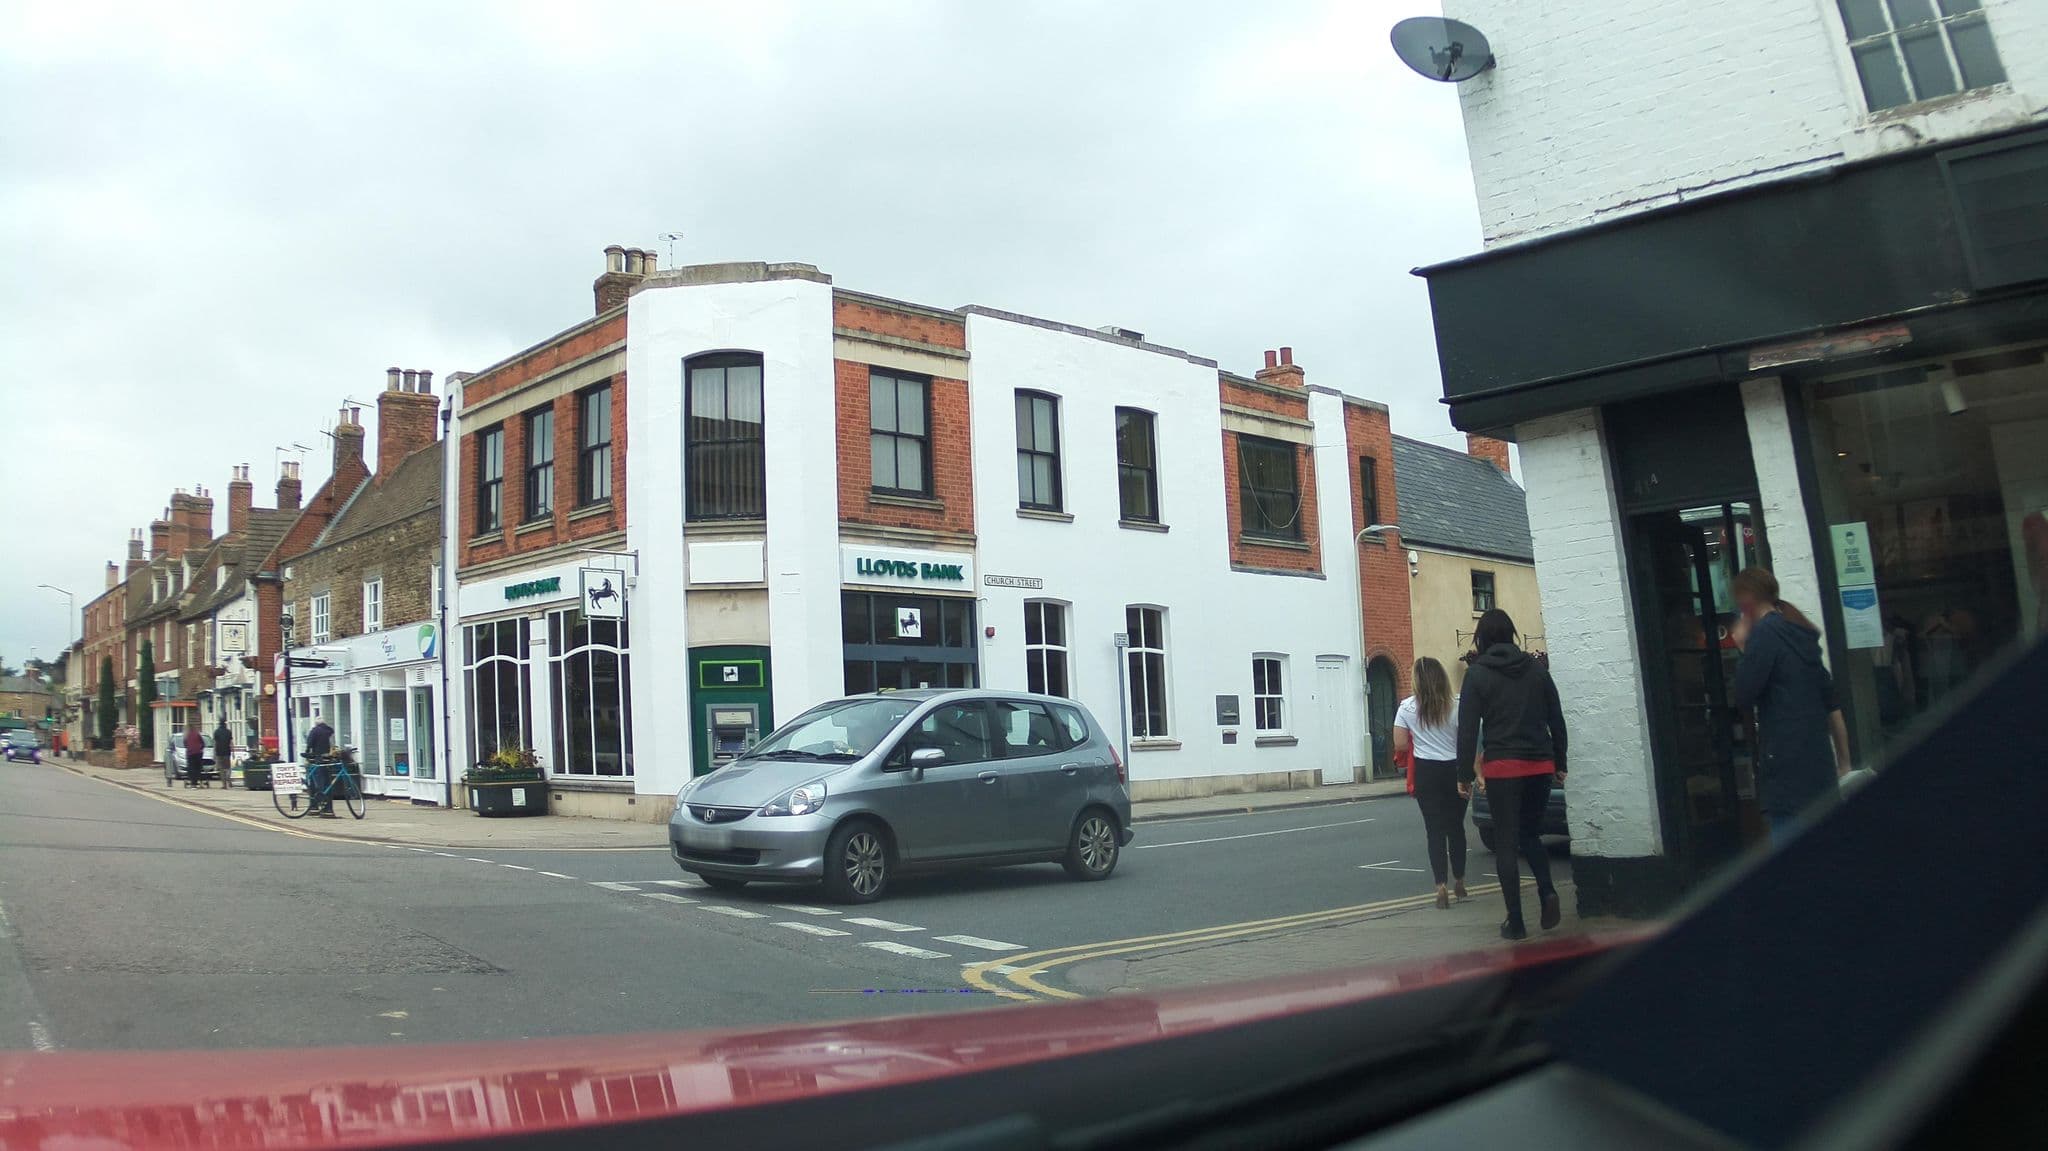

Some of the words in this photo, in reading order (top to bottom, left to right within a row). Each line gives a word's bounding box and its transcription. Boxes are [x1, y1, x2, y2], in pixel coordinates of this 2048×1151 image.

[857, 557, 918, 578] LLOYDS
[921, 562, 964, 581] BANK
[986, 576, 1014, 585] CHURCH
[1016, 579, 1041, 588] STREET
